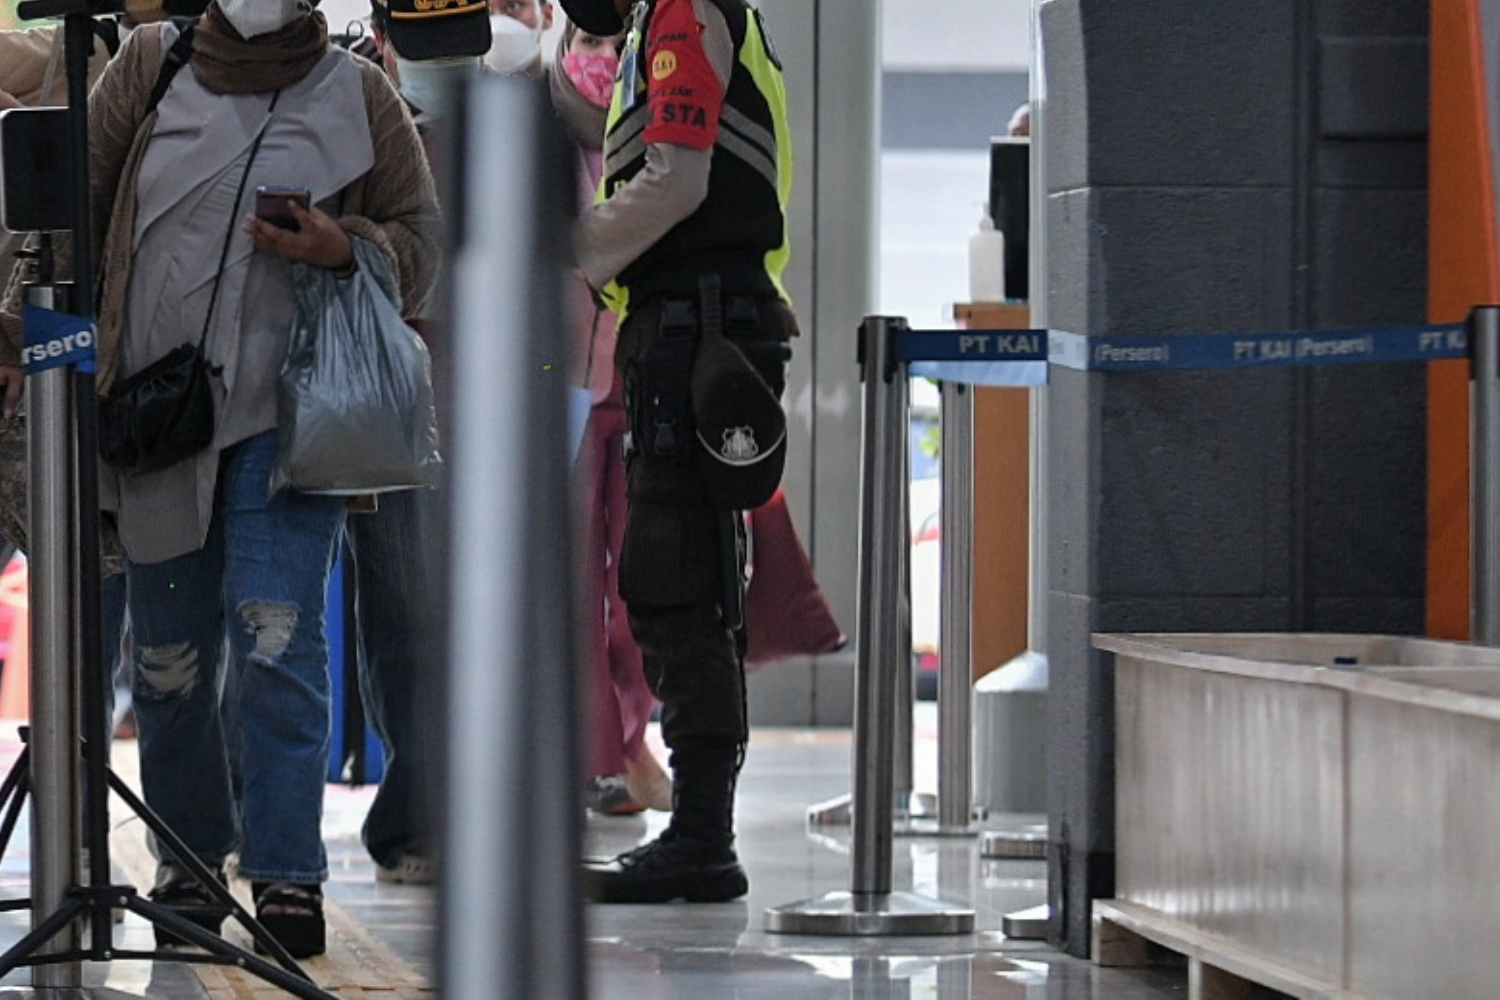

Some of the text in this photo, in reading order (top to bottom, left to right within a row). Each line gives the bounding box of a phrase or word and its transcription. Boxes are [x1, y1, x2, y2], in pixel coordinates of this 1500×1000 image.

[661, 103, 707, 129] STA
[21, 323, 98, 365] rsero)
[959, 334, 1040, 354] PT KAI
[1094, 342, 1169, 366] (Persero)
[1233, 333, 1374, 361] PT KAI (Persero)
[1419, 331, 1443, 352] PT
